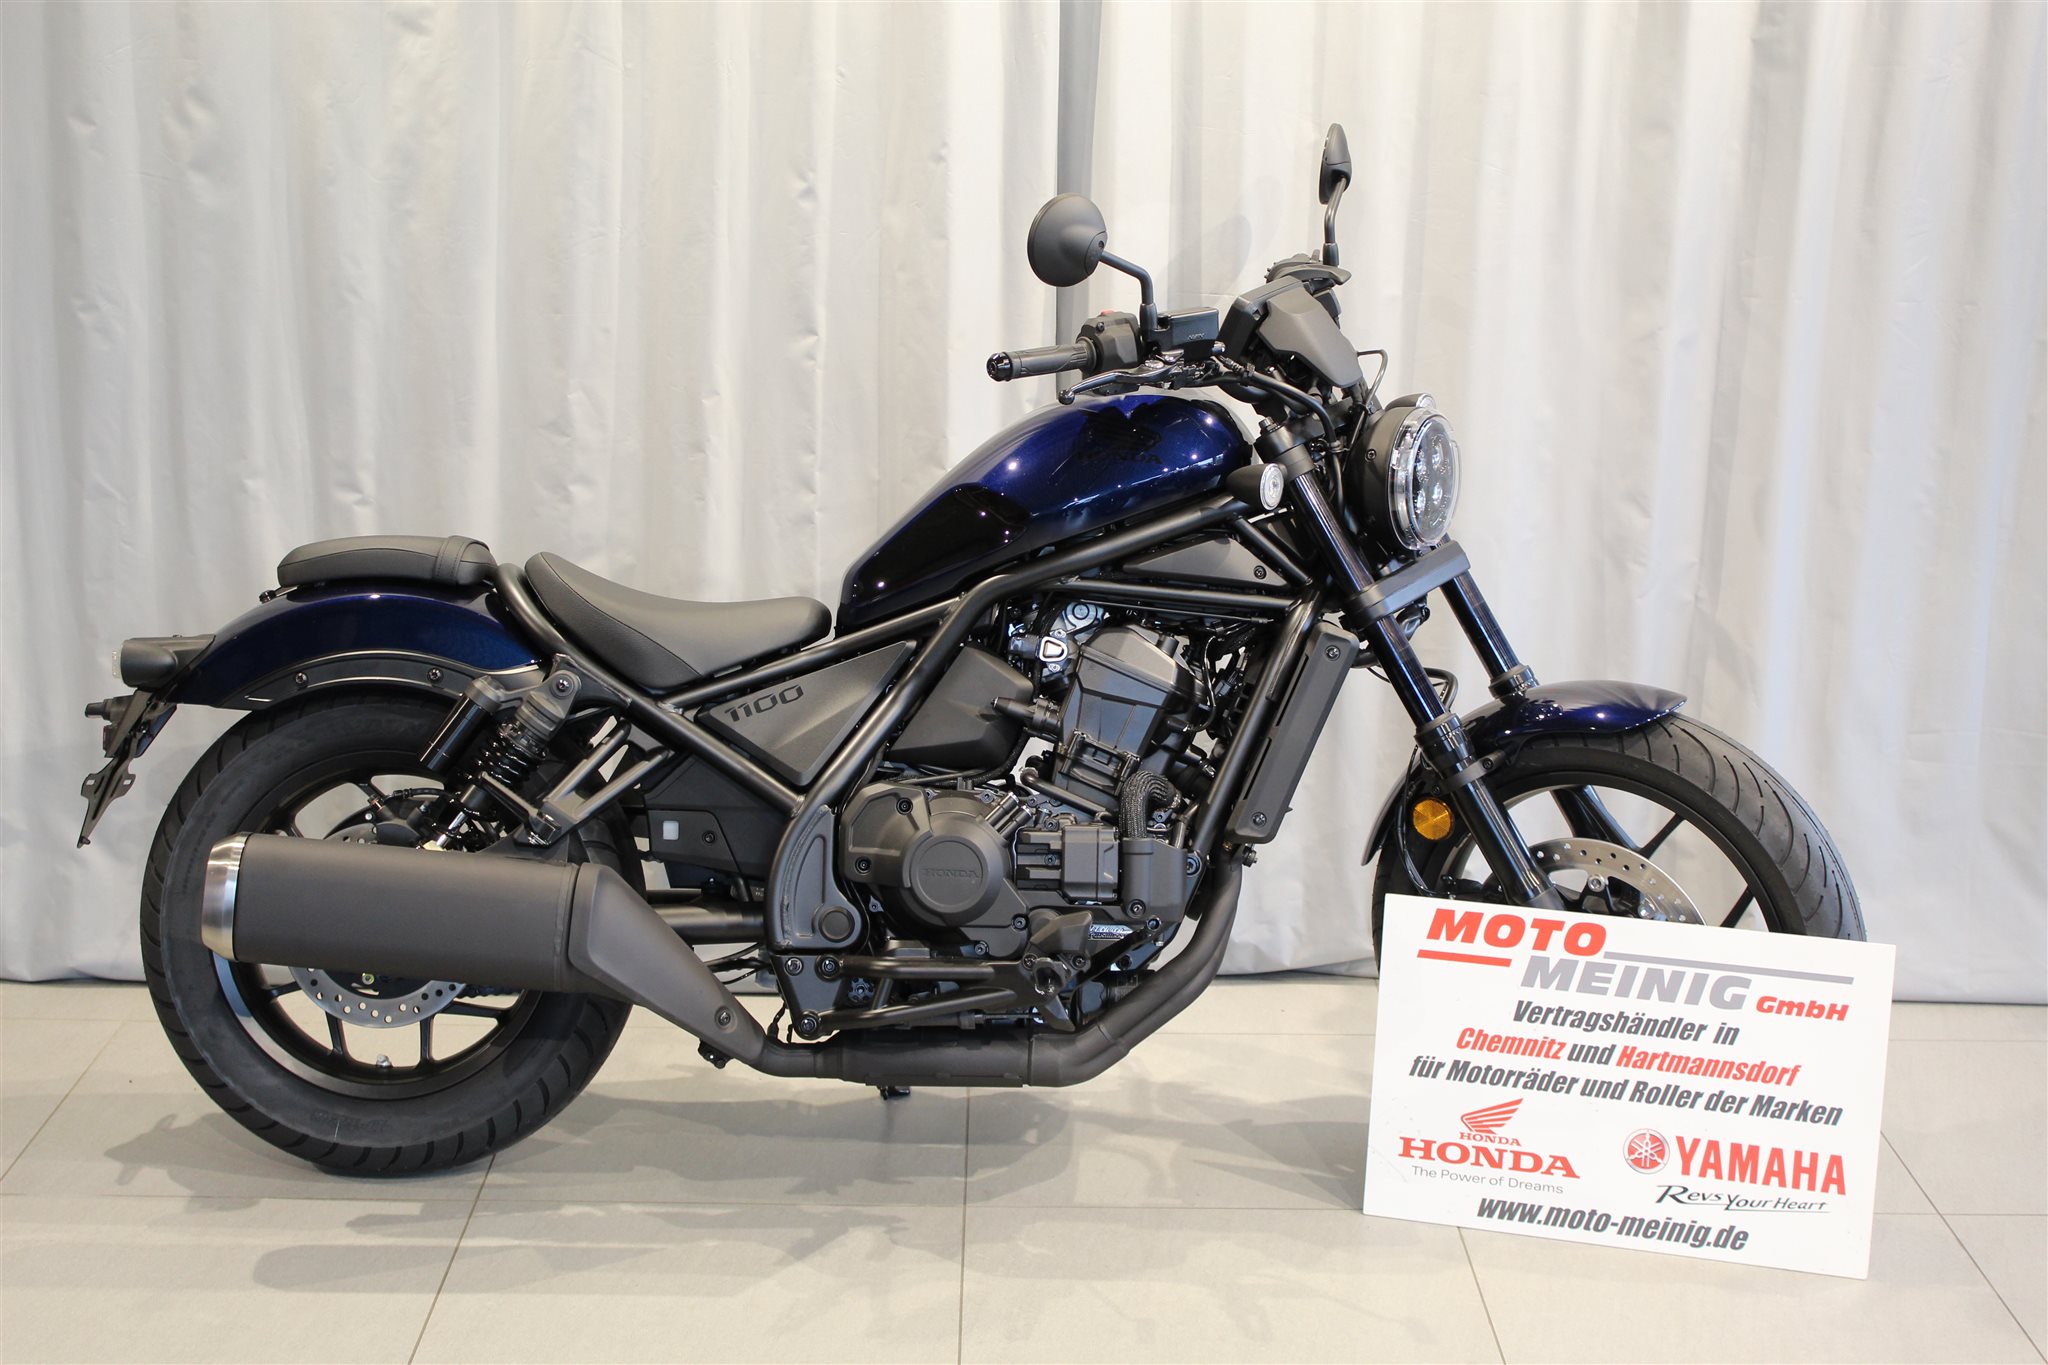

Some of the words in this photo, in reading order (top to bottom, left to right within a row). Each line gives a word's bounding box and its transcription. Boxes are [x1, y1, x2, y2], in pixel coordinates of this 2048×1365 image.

[724, 684, 804, 722] 1100
[921, 868, 979, 879] HONDA
[1427, 908, 1606, 956] MOTO
[1521, 955, 1752, 1010] MEINIG
[1756, 996, 1849, 1021] GmbH
[1513, 1000, 1708, 1042] Vertragshändler
[1713, 1022, 1740, 1045] in
[1456, 1027, 1567, 1060] Chemnitz
[1567, 1043, 1617, 1065] und
[1615, 1045, 1802, 1087] Hartmannsdorf
[1409, 1056, 1446, 1078] für
[1446, 1059, 1579, 1094] Motorräder
[1580, 1078, 1629, 1101] und
[1628, 1080, 1704, 1109] Roller
[1704, 1090, 1749, 1115] der
[1749, 1094, 1843, 1126] Marken
[1398, 1137, 1580, 1179] HONDA
[1458, 1132, 1522, 1147] HONDA
[1411, 1165, 1437, 1178] The
[1441, 1169, 1486, 1184] Power
[1489, 1176, 1504, 1186] of
[1508, 1177, 1564, 1194] Dreams
[1675, 1135, 1847, 1196] YAMAHA
[1655, 1184, 1725, 1205] Revs
[1724, 1194, 1773, 1211] Your
[1774, 1197, 1829, 1211] Heart
[1477, 1198, 1749, 1250] www.moto-meinig.de
